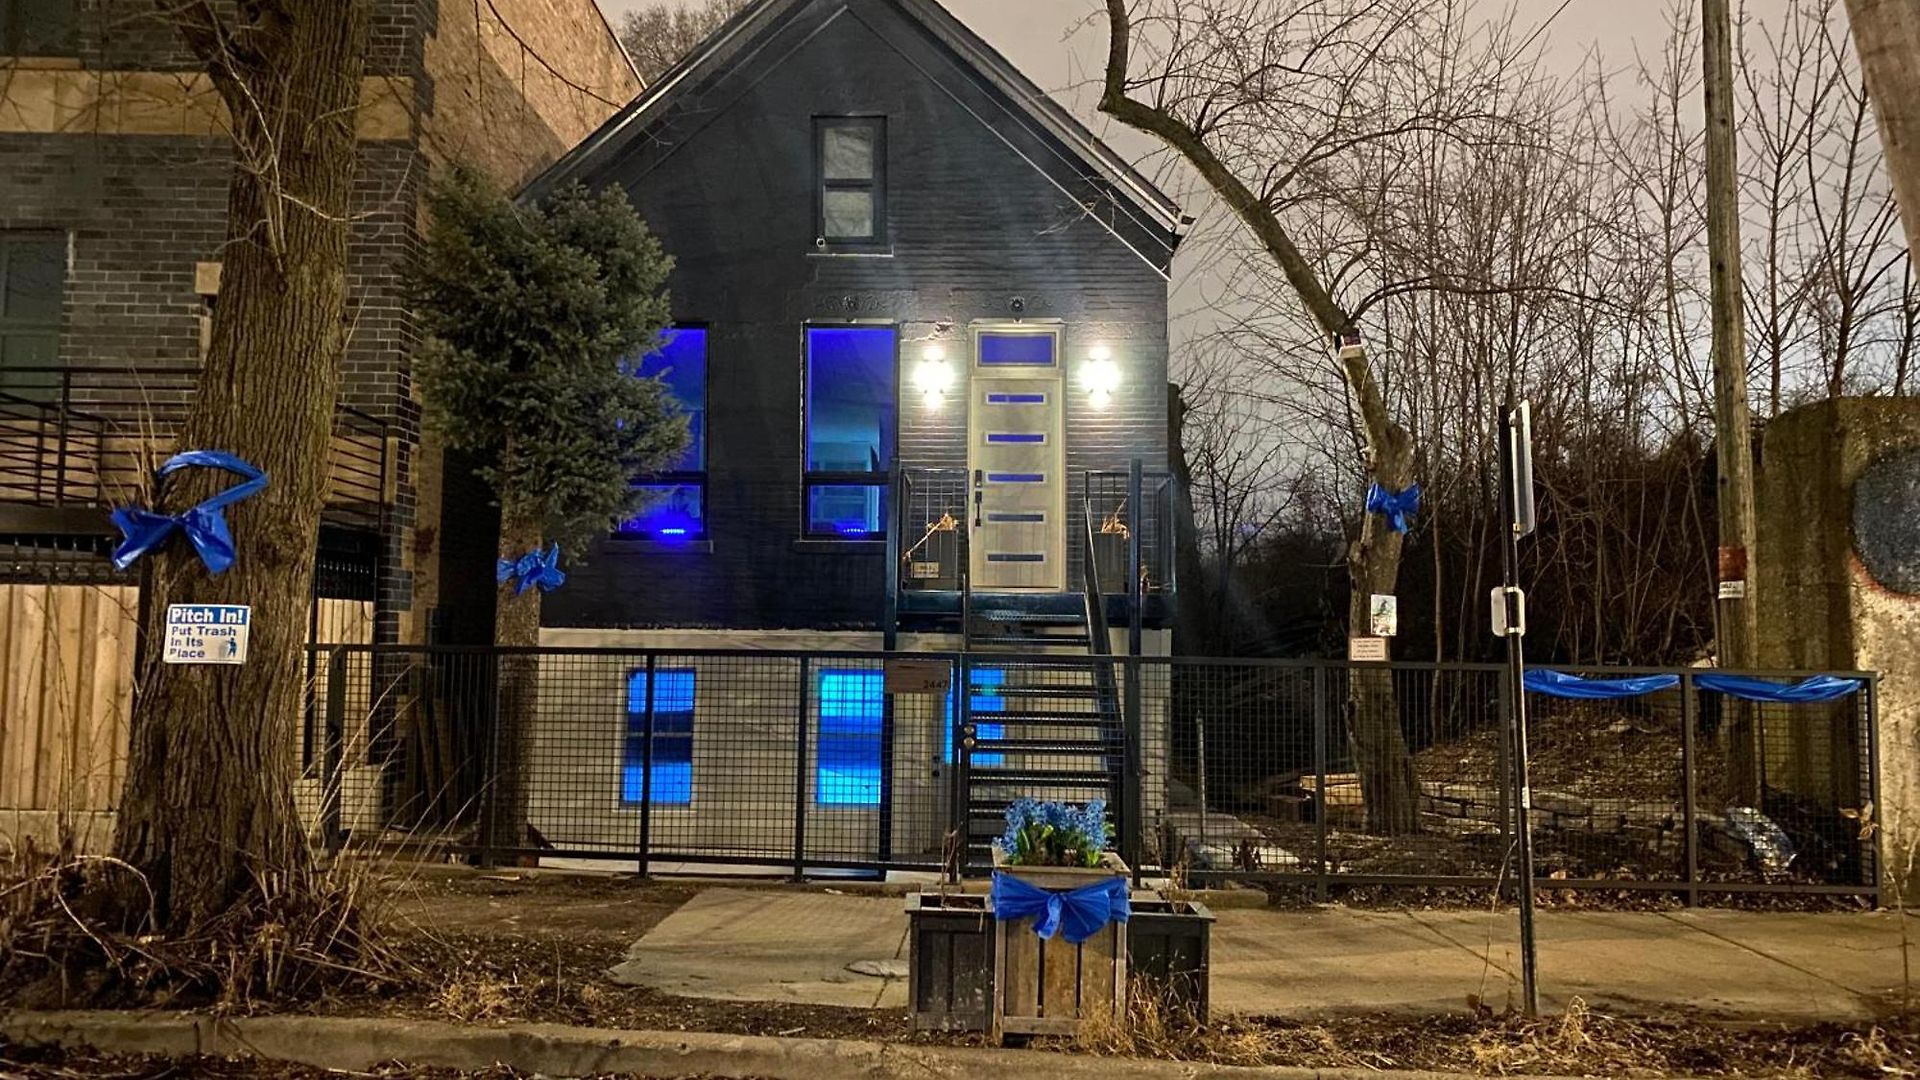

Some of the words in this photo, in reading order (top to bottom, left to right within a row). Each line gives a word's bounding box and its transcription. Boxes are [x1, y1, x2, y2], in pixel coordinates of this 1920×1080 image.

[172, 608, 214, 623] Pitch
[220, 609, 244, 623] In!
[171, 626, 192, 636] Put
[197, 626, 236, 636] Trash
[170, 637, 182, 646] In
[186, 637, 204, 647] Its
[169, 648, 205, 658] Place
